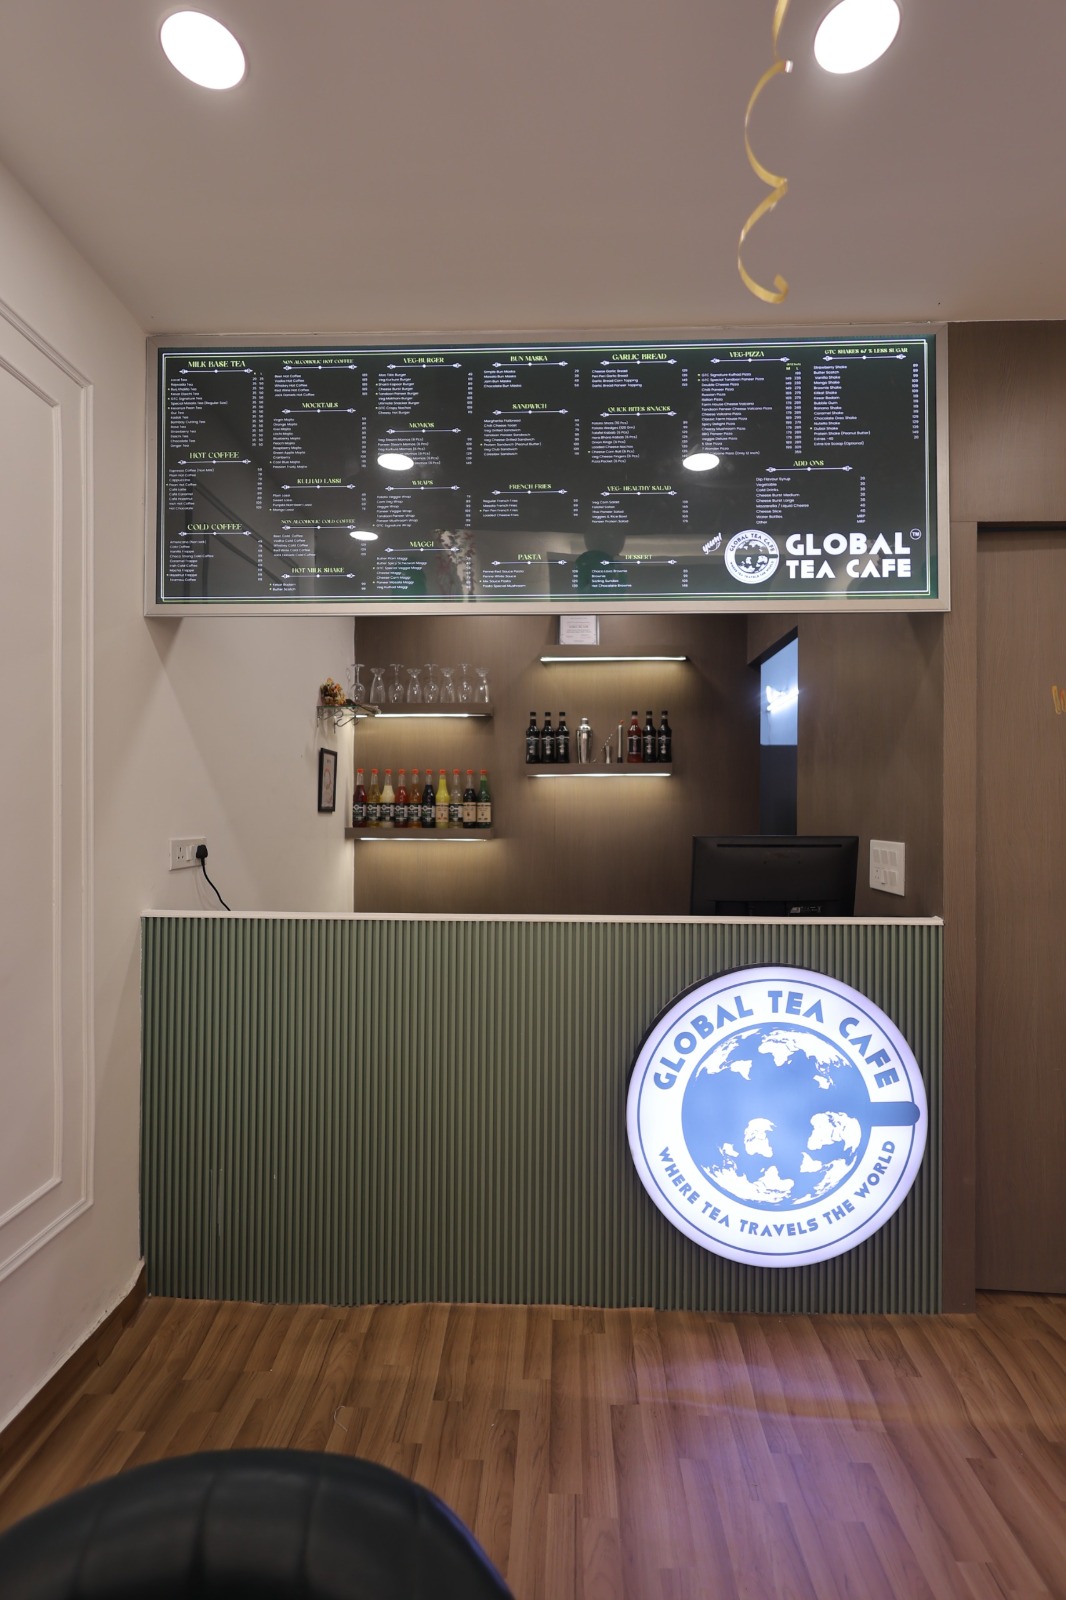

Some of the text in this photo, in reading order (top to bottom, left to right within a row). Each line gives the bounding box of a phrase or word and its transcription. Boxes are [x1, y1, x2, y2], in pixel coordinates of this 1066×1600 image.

[729, 534, 748, 552] GLOBAL
[764, 538, 775, 552] CAFE
[785, 532, 910, 555] GLOBAL
[786, 558, 911, 579] TEA CAFE
[653, 991, 900, 1090] GLOBAL TEA CAFE
[658, 1140, 895, 1237] WHERE TEA TRAVELS THE WORLD
